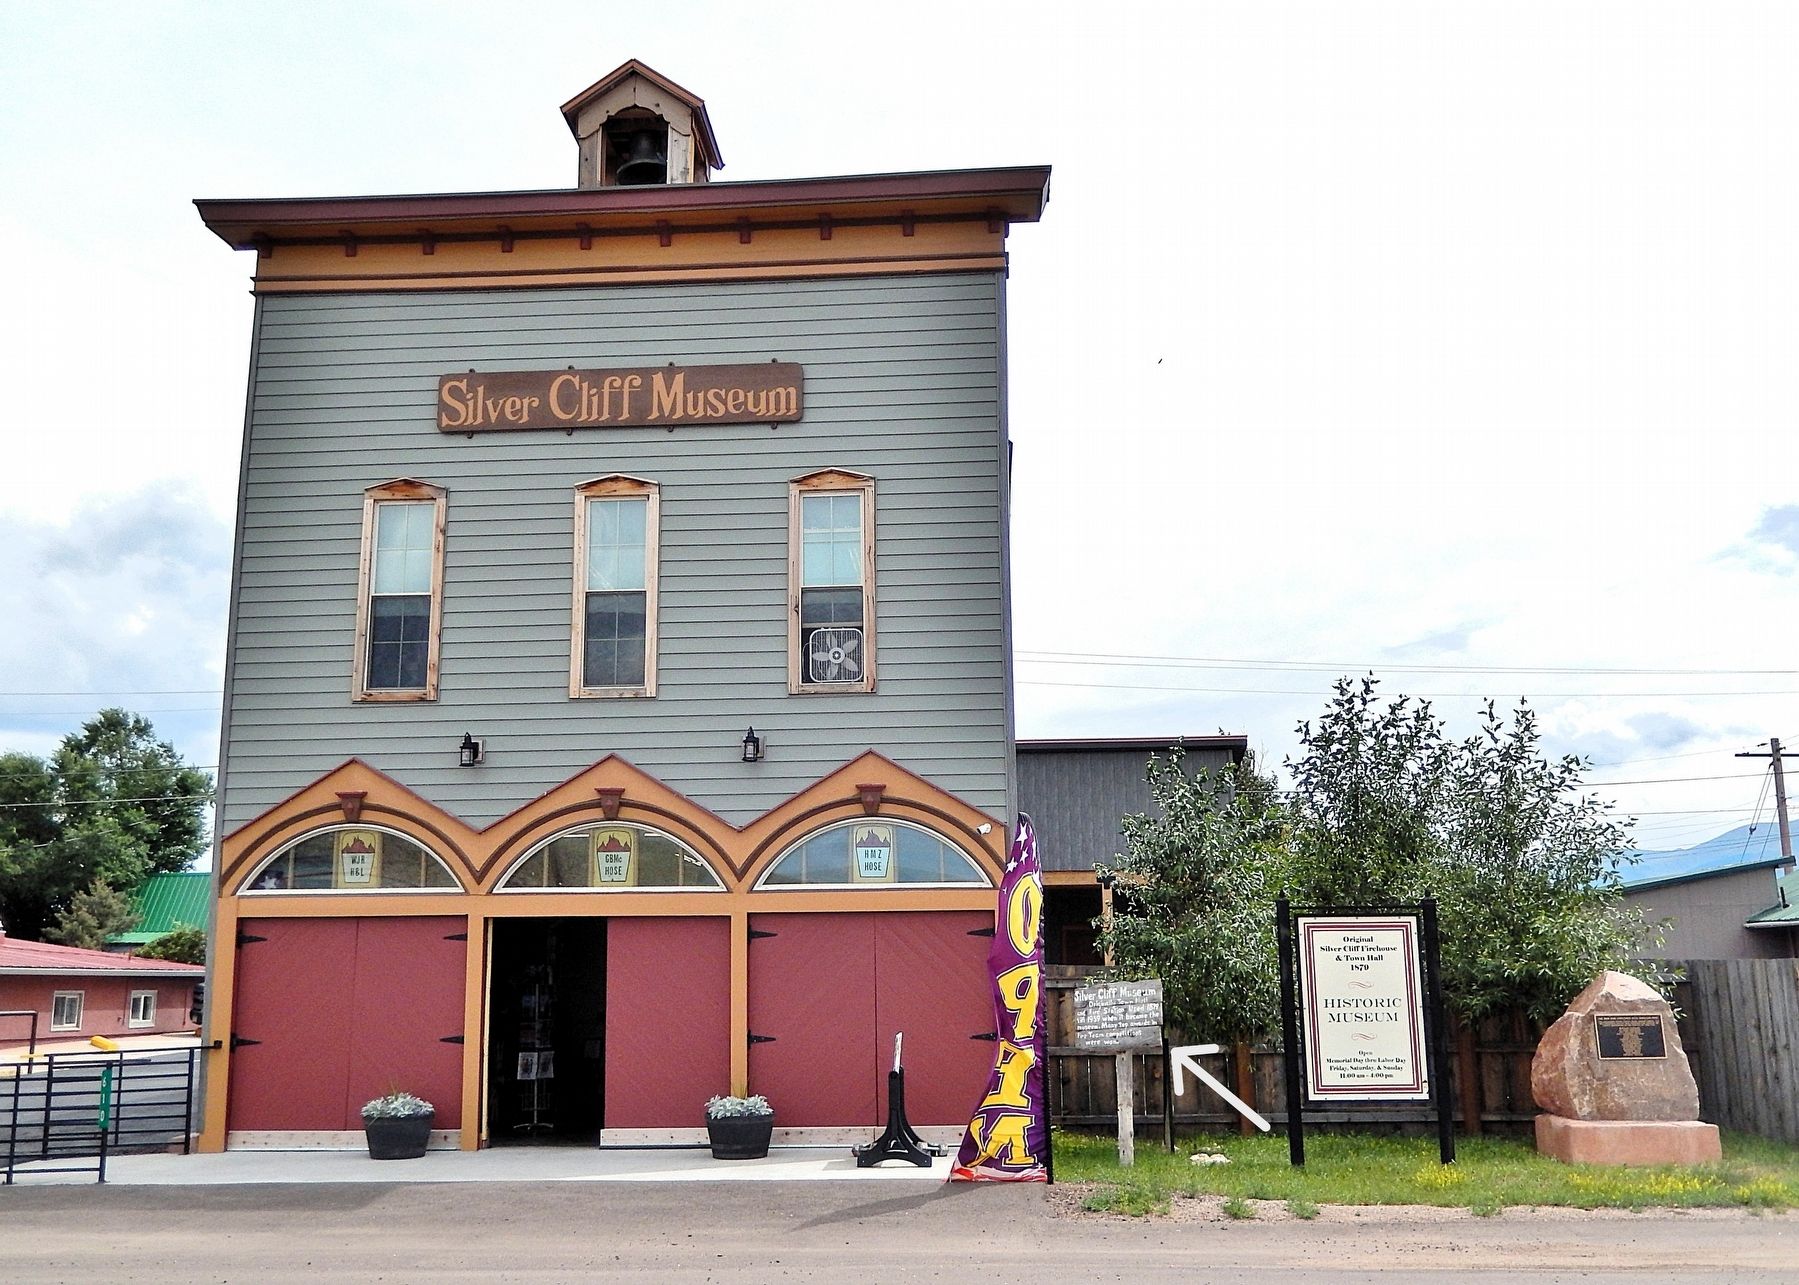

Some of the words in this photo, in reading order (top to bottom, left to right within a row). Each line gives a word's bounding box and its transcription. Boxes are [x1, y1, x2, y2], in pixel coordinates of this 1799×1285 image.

[441, 379, 539, 427] Silver
[549, 374, 641, 421] Cliff
[648, 371, 798, 421] Museum
[605, 866, 622, 875] HOSE
[865, 862, 882, 871] HOSE
[350, 868, 364, 876] H&L
[1074, 990, 1096, 1001] Silver
[1098, 988, 1117, 999] Cliff
[1120, 987, 1156, 998] Museum
[1324, 998, 1401, 1008] HISTORIC
[1150, 1010, 1159, 1018] the
[1328, 1012, 1398, 1022] MUSEUM
[1102, 1022, 1117, 1030] Many
